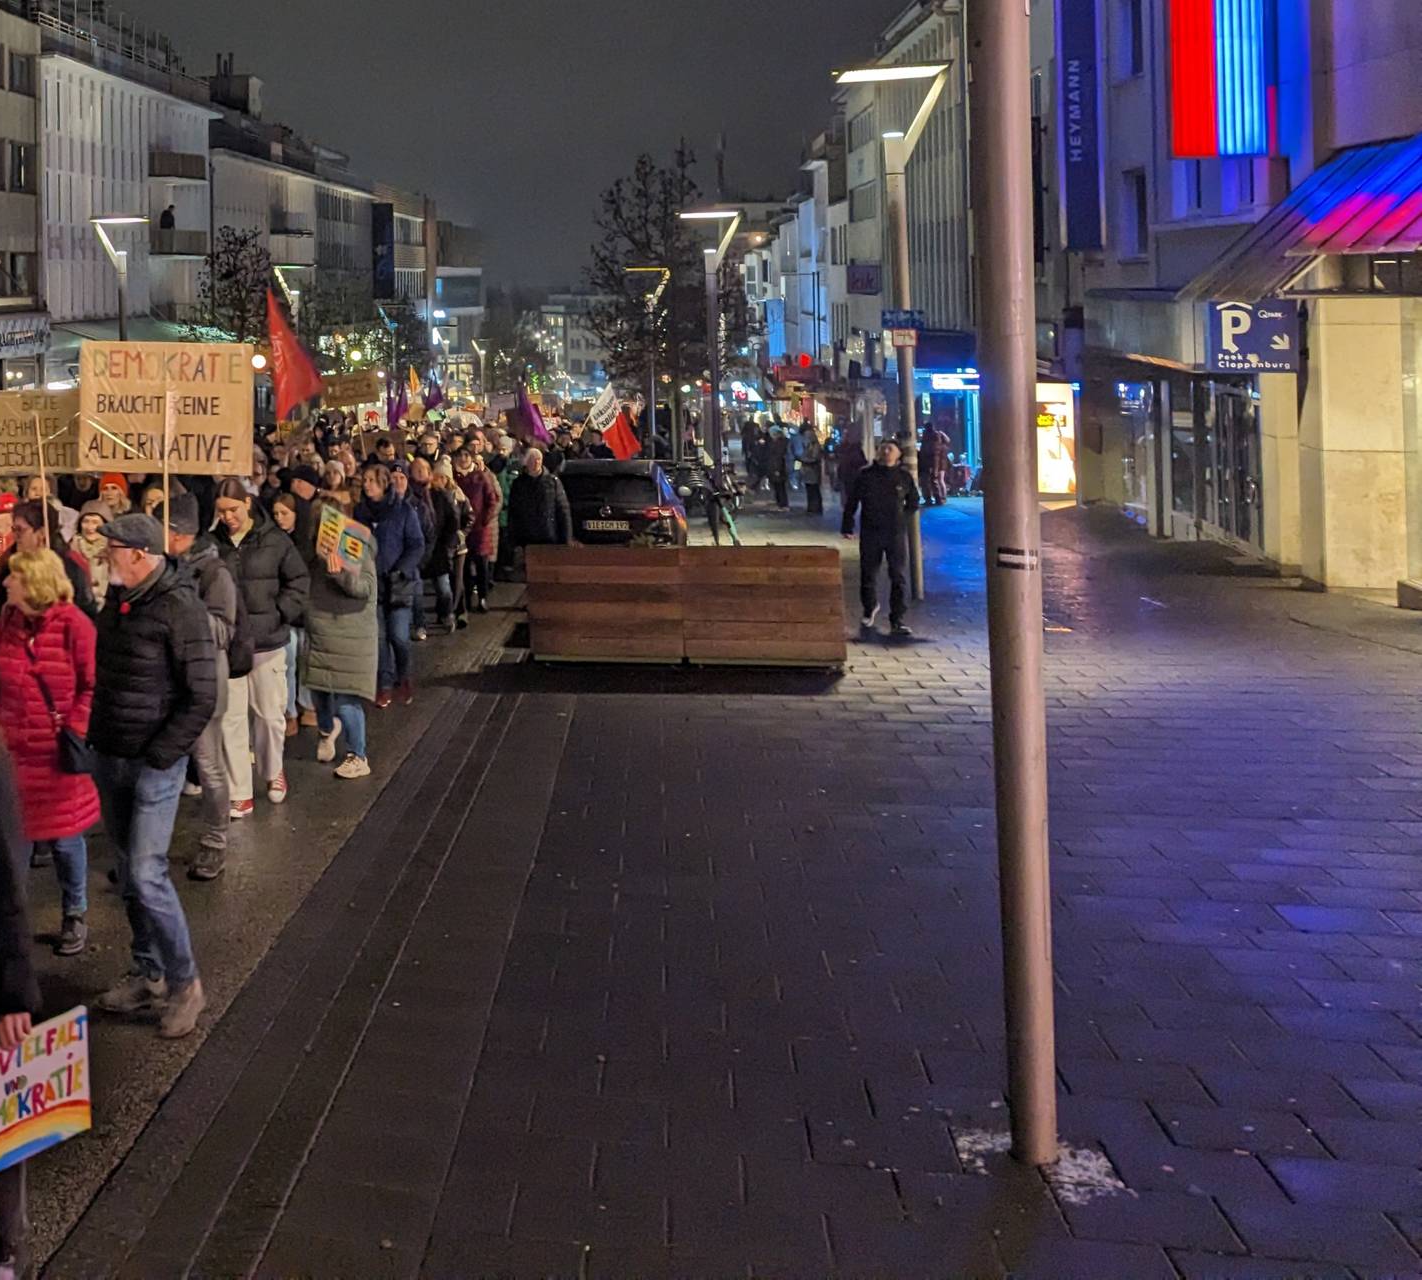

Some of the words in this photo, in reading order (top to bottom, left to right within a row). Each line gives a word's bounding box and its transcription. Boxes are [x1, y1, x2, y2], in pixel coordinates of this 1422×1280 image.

[1068, 60, 1083, 162] HEYMANN
[92, 349, 243, 384] DEMOKRATIE
[1218, 353, 1244, 361] Peek
[1218, 361, 1291, 370] Cloppenburg
[96, 393, 165, 414] BRAUCHT
[85, 431, 233, 463] ALTERNATIVE
[4, 1075, 28, 1096] UND
